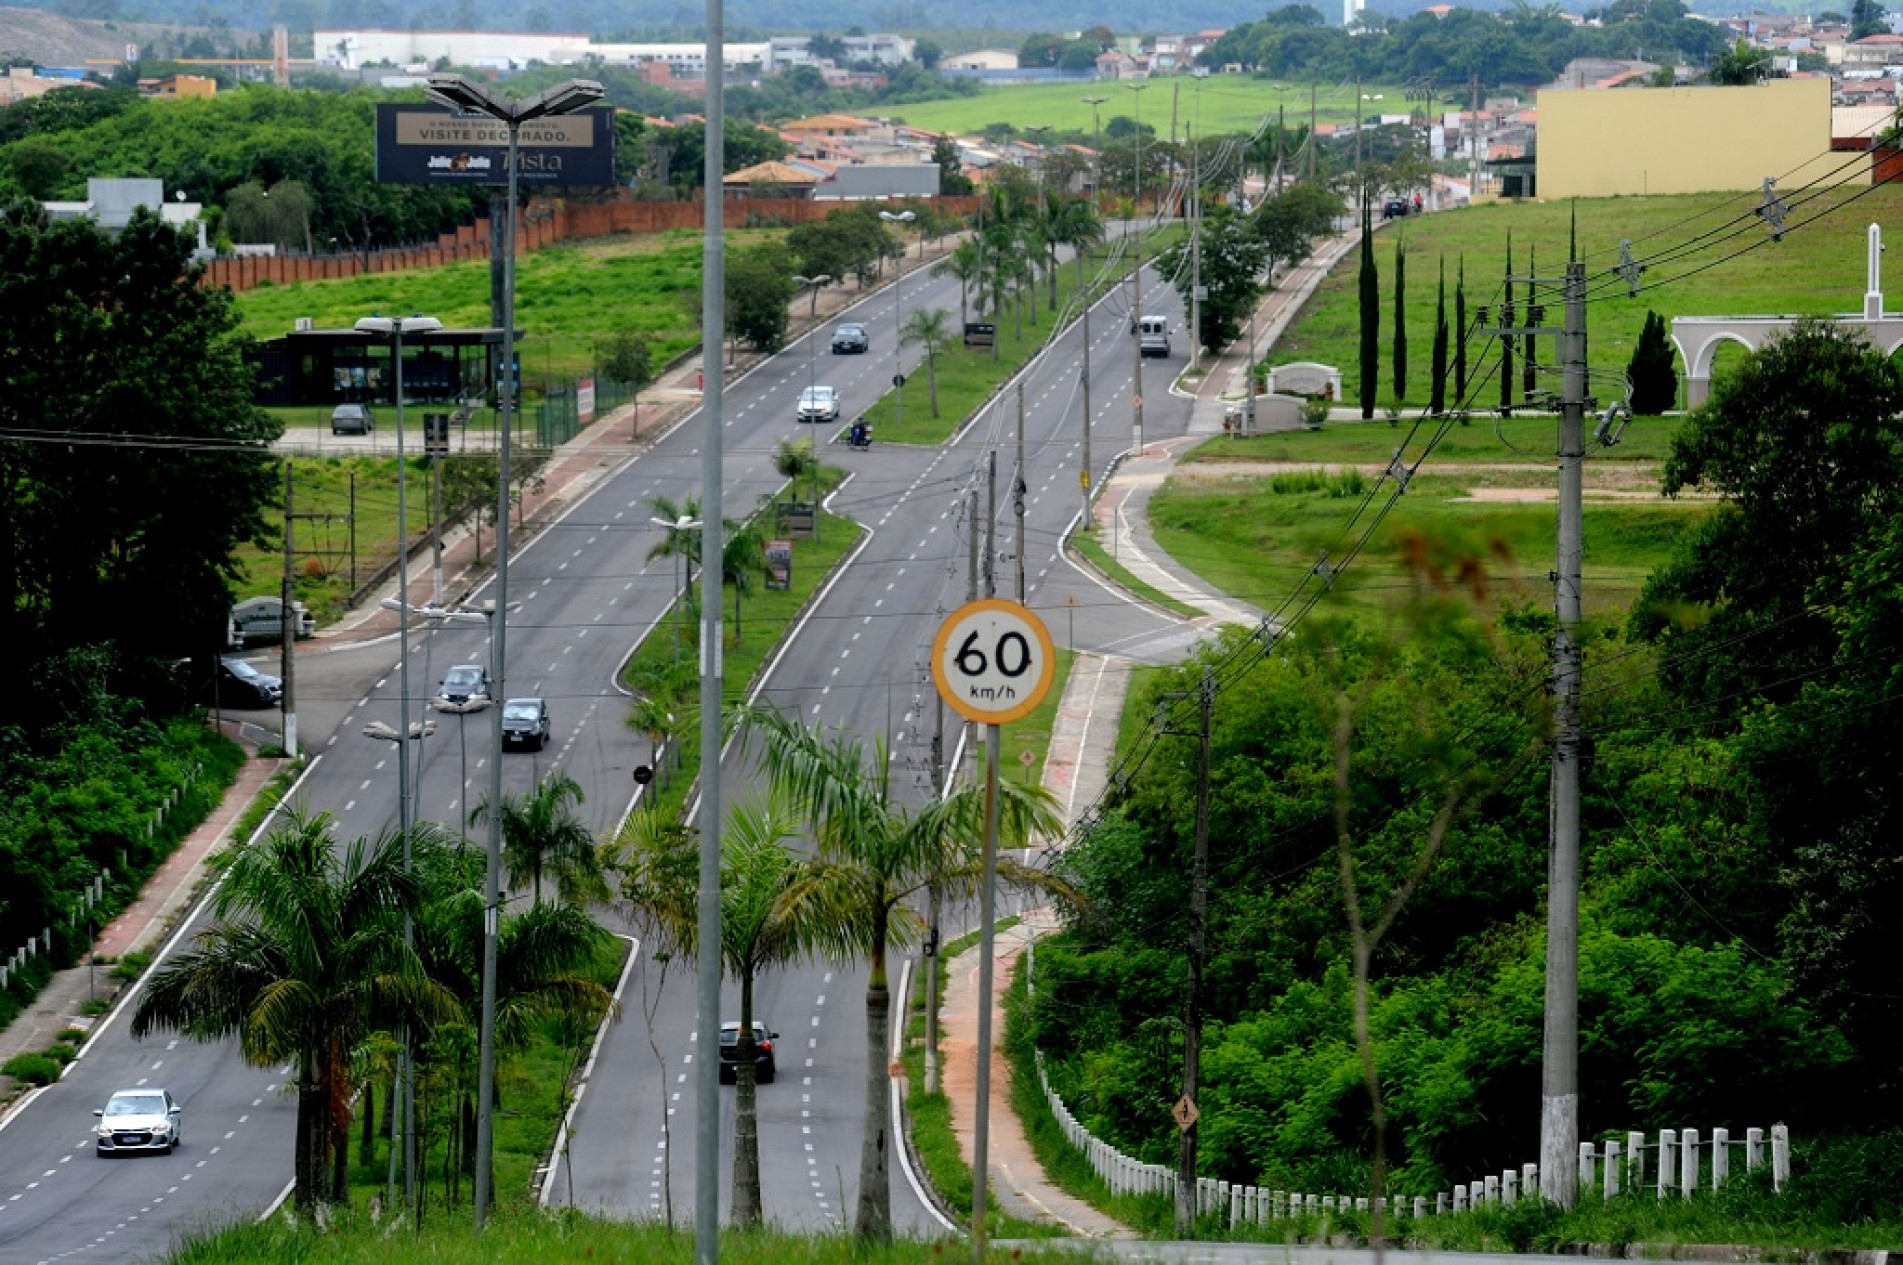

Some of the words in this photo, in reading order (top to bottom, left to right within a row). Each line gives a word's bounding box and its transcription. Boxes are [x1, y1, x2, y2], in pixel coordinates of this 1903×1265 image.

[419, 129, 471, 141] VISITE
[477, 130, 570, 142] DECRADO.
[956, 630, 1031, 678] 60
[970, 685, 1015, 700] km/h
